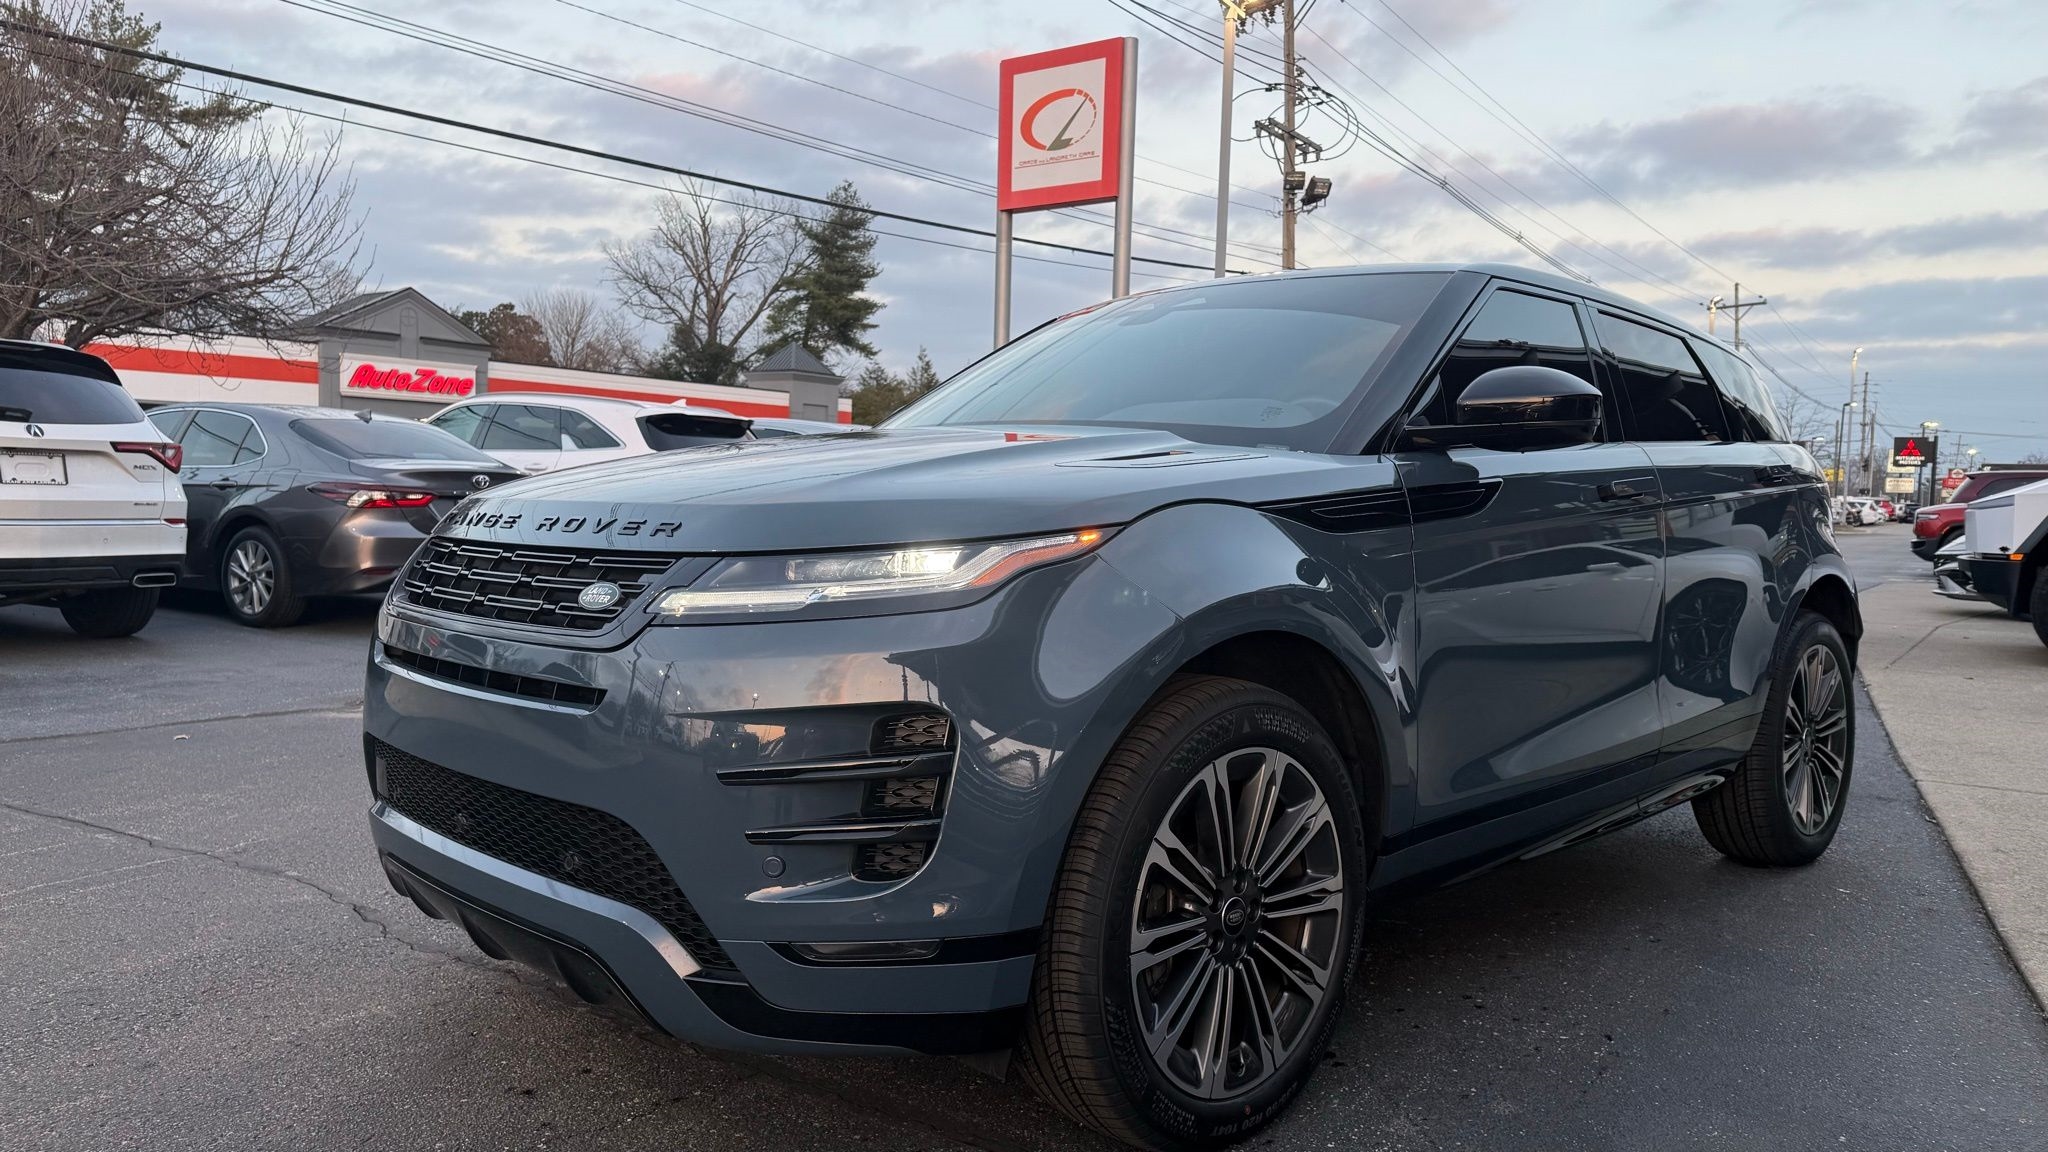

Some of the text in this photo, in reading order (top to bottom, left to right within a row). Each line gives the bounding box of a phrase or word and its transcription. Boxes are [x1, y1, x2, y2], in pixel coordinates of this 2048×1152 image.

[348, 363, 474, 396] AutoZone
[535, 515, 683, 537] ROVER
[588, 586, 608, 595] LAND
[585, 594, 611, 604] ROVER
